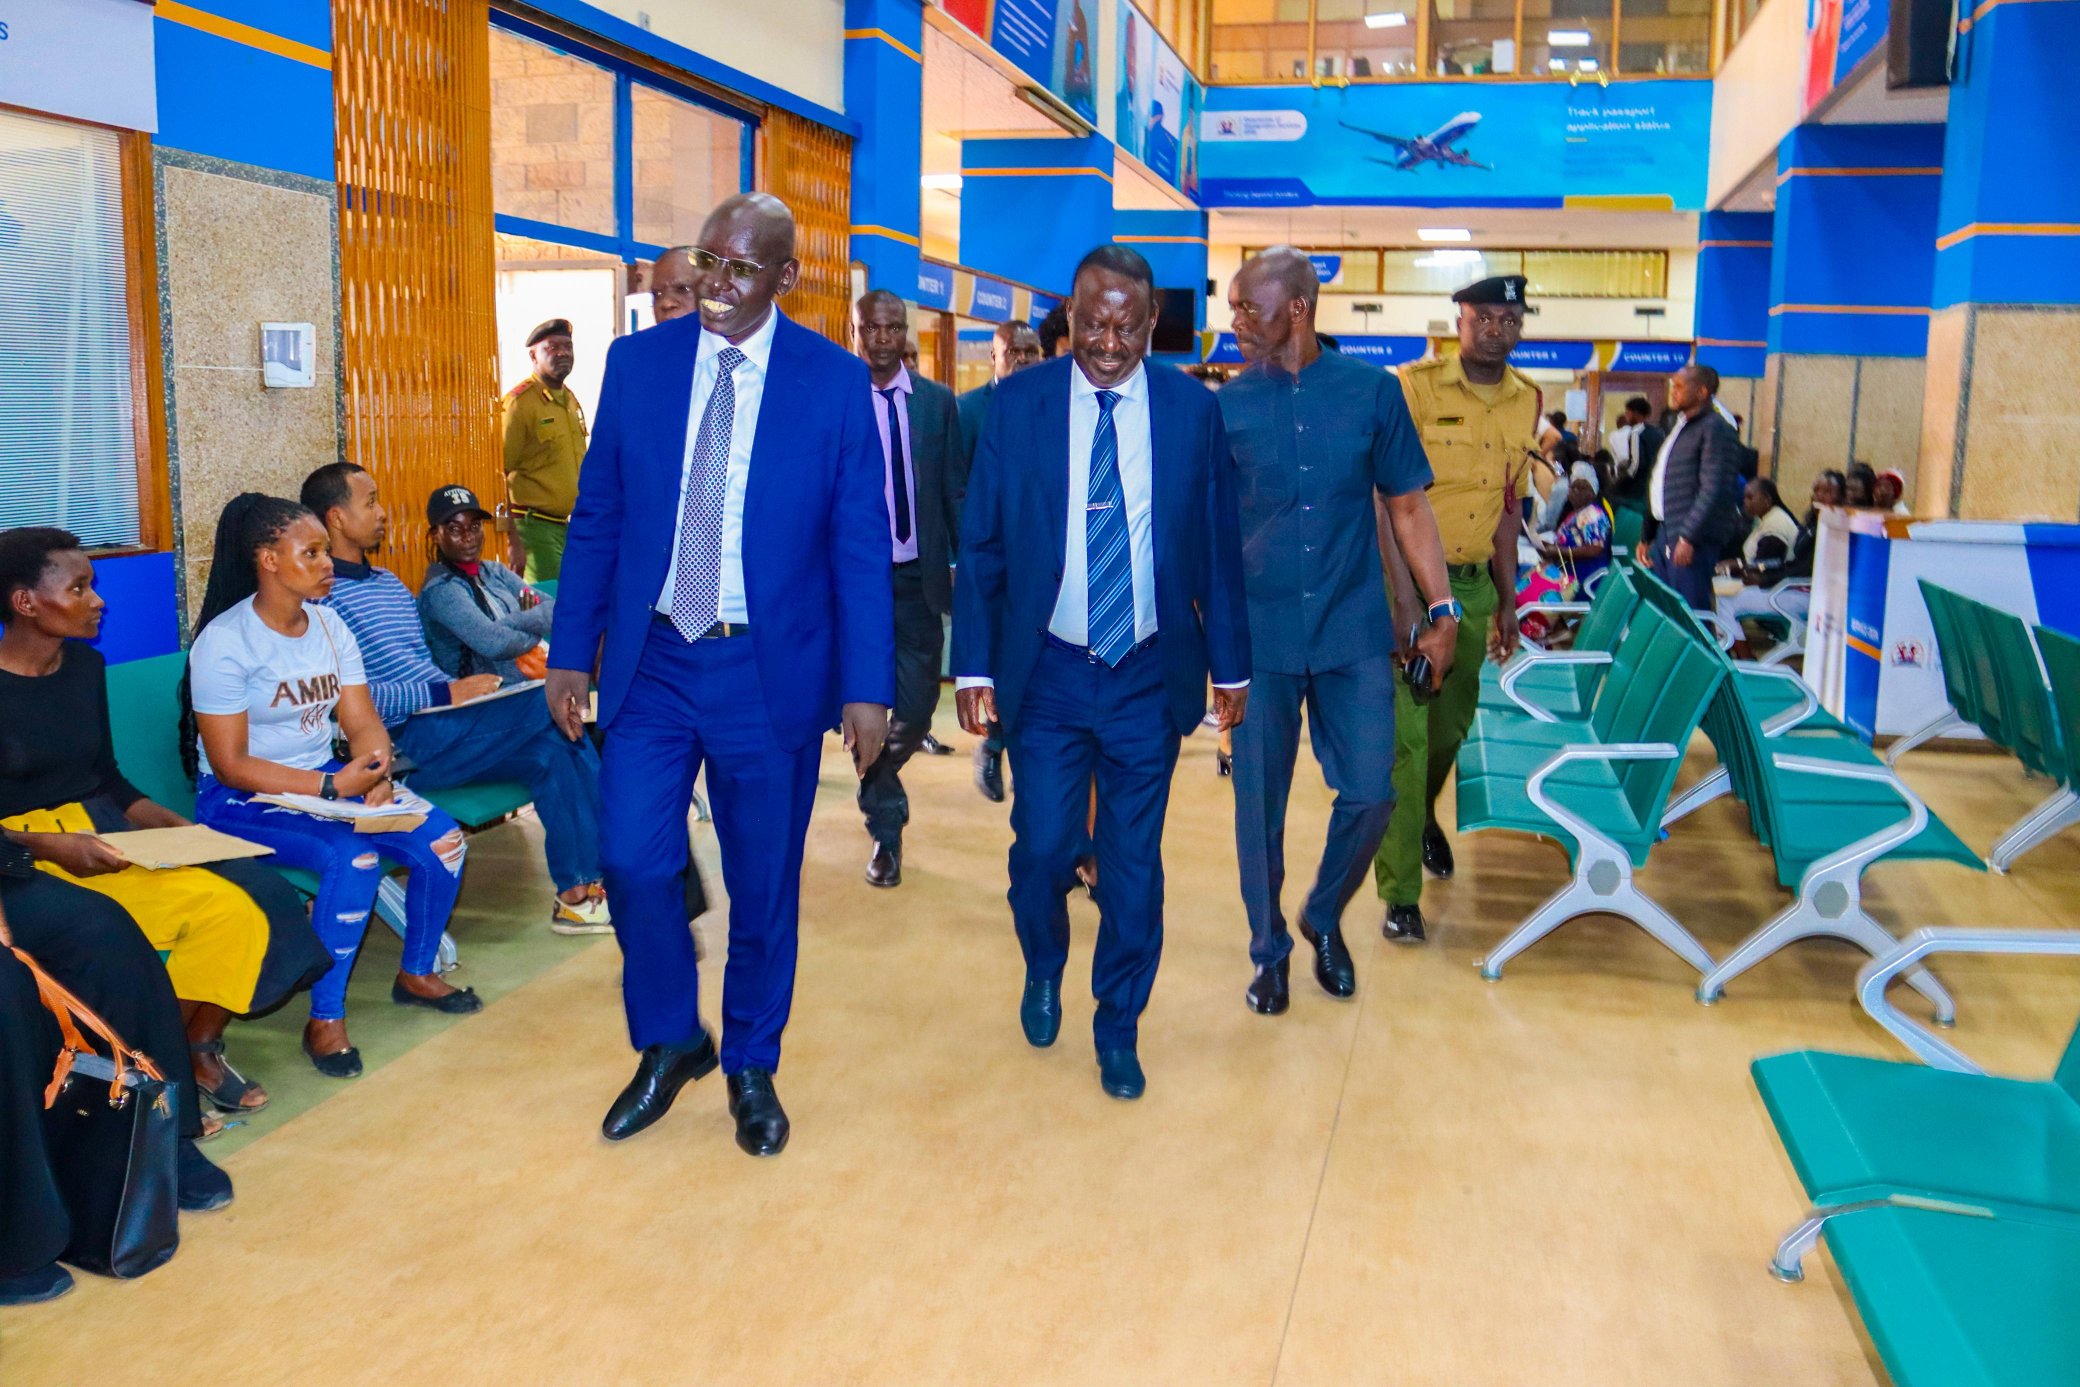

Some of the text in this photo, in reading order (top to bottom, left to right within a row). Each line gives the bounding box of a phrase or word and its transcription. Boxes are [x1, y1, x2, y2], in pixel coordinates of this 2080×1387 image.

[977, 290, 1001, 309] COUNTER
[1340, 345, 1384, 355] COUNTER
[1509, 350, 1549, 360] OUNTER
[1623, 352, 1669, 363] COUNTER
[270, 673, 340, 707] AMIR
